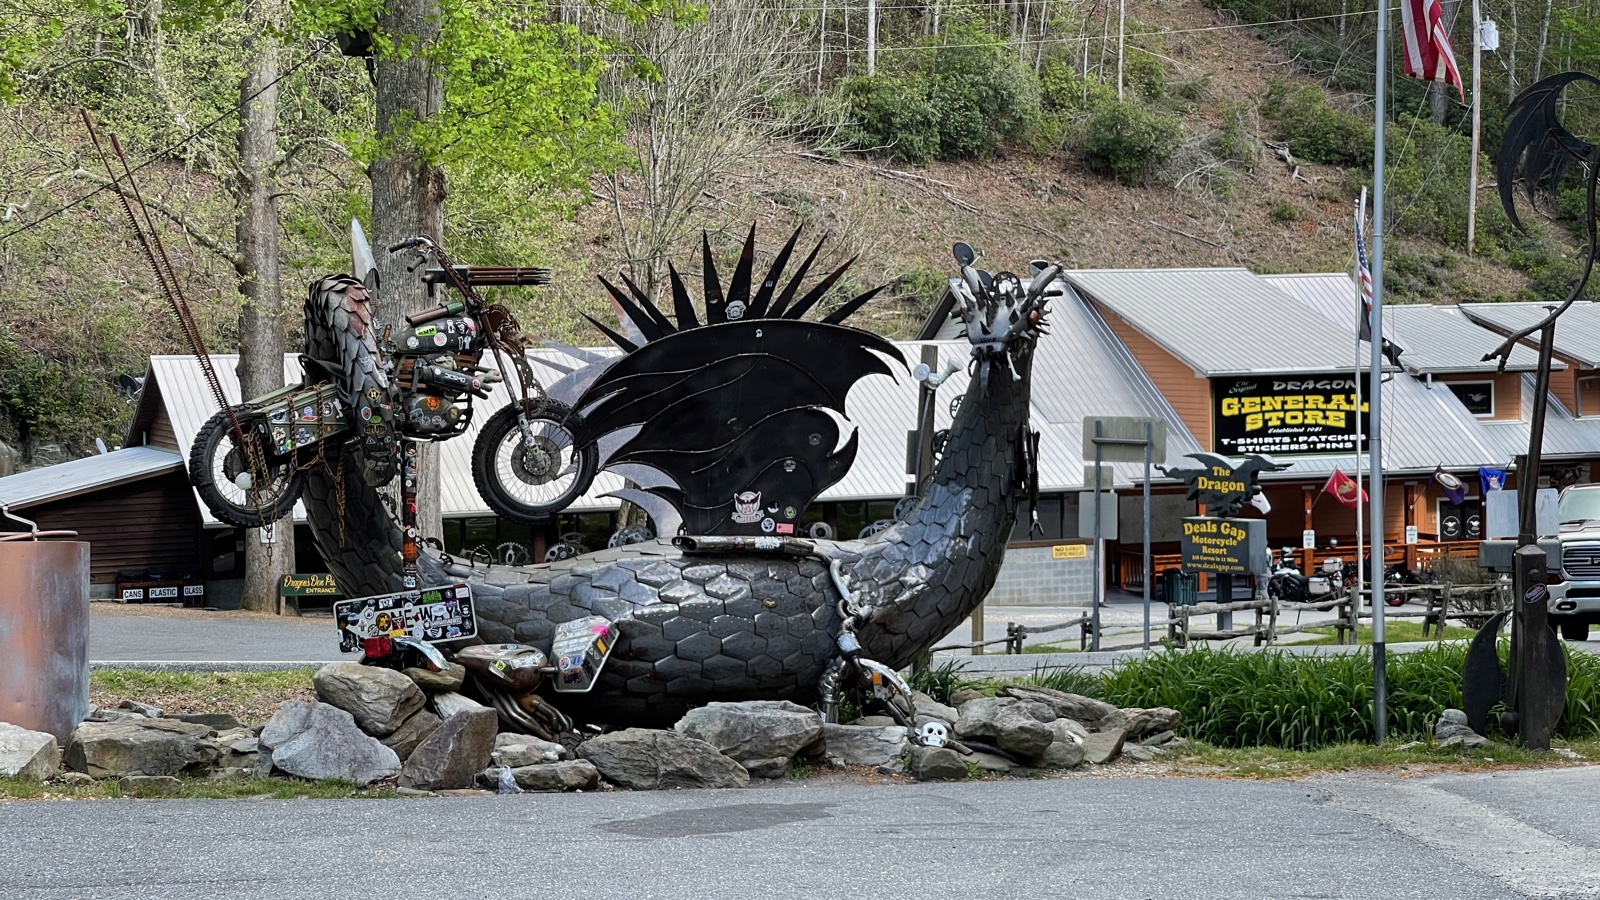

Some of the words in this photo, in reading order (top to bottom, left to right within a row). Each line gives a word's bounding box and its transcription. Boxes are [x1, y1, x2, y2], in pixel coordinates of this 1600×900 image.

[1229, 383, 1257, 394] Original
[1272, 380, 1356, 391] DRAGON
[1222, 394, 1369, 417] GENERAL
[1245, 410, 1346, 432] STORE
[1268, 426, 1305, 434] Established
[1221, 436, 1291, 445] T-SHIRTS
[1298, 434, 1366, 442] PATCHES
[1237, 443, 1309, 452] STICKERS
[1316, 441, 1353, 450] PINS
[1212, 466, 1230, 476] The
[1197, 476, 1245, 493] Dragon
[1183, 520, 1217, 535] Deals
[1220, 522, 1246, 541] Gap
[1192, 535, 1237, 547] Motorcycle
[1202, 546, 1227, 554] Resort
[1186, 562, 1244, 571] www.dealsgap.com
[123, 590, 142, 599] CANS
[150, 588, 177, 597] PLASTIC
[184, 586, 203, 595] GLASS
